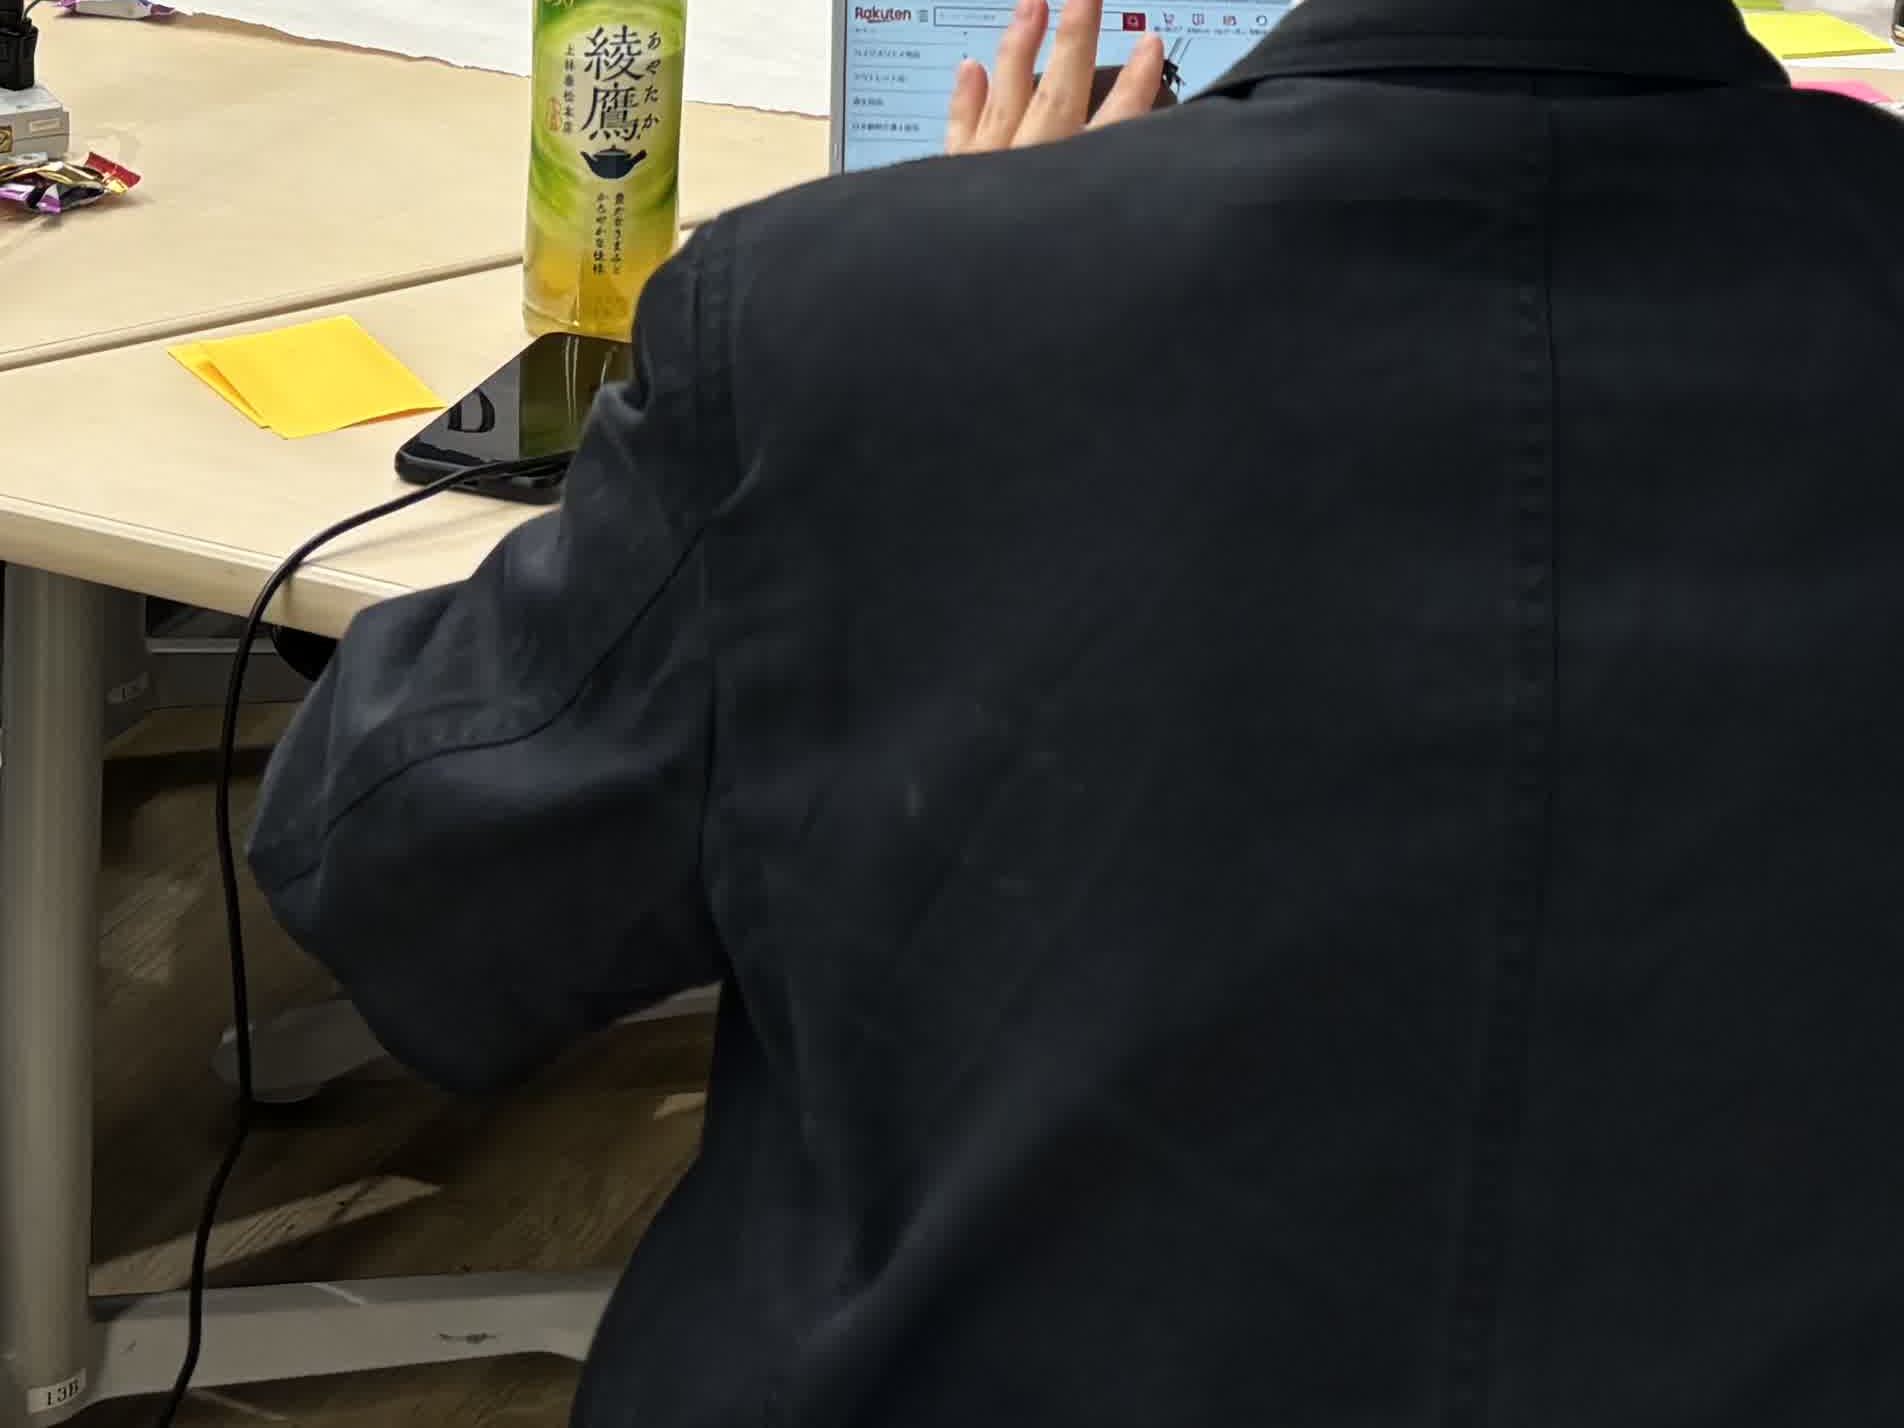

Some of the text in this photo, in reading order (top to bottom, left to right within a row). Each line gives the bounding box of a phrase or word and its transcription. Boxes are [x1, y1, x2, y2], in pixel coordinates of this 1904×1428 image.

[854, 5, 912, 22] Rakuten
[580, 25, 644, 141] 綾鷹
[642, 31, 662, 130] あやたか
